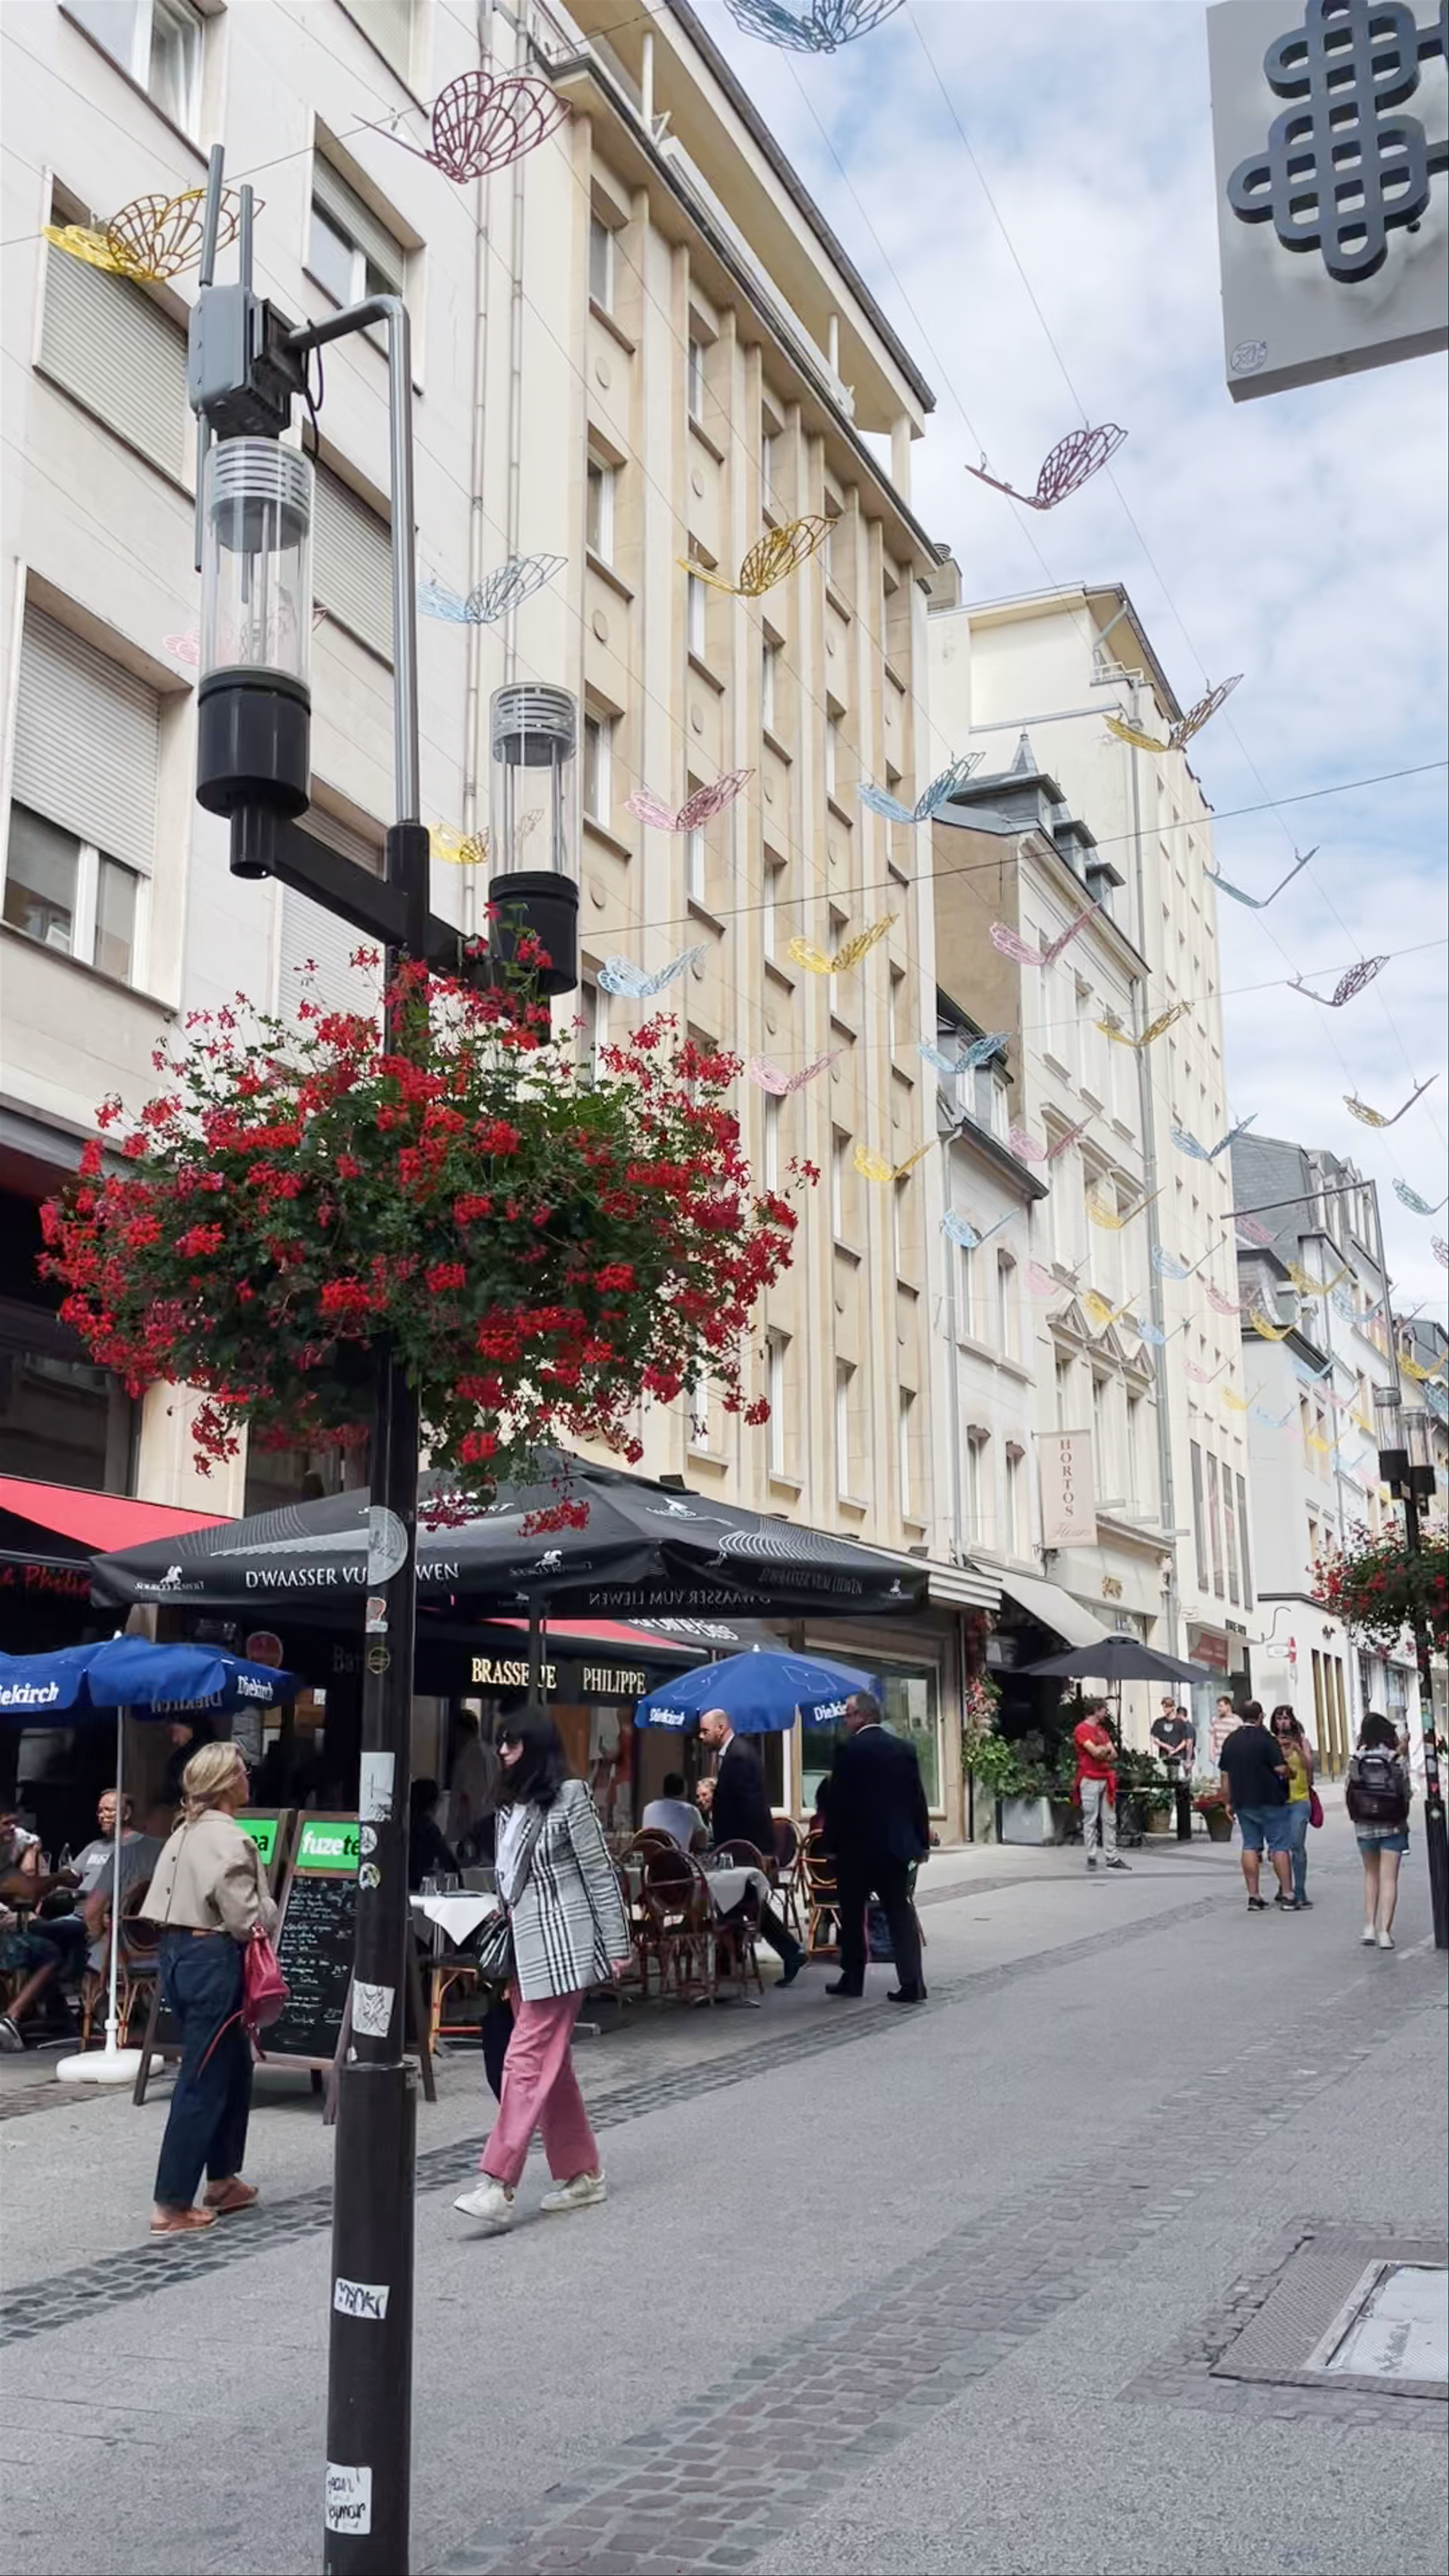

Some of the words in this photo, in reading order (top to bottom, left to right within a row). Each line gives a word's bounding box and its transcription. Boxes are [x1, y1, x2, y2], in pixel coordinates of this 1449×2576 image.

[1059, 1438, 1074, 1517] HORTOS
[246, 1569, 337, 1587] D'WAASSER
[342, 1567, 368, 1584] VU
[238, 1675, 274, 1701] Diekirch
[472, 1658, 558, 1689] BRASSEIE
[583, 1667, 646, 1694] PHILIPPE
[302, 1830, 360, 1856] fuzete
